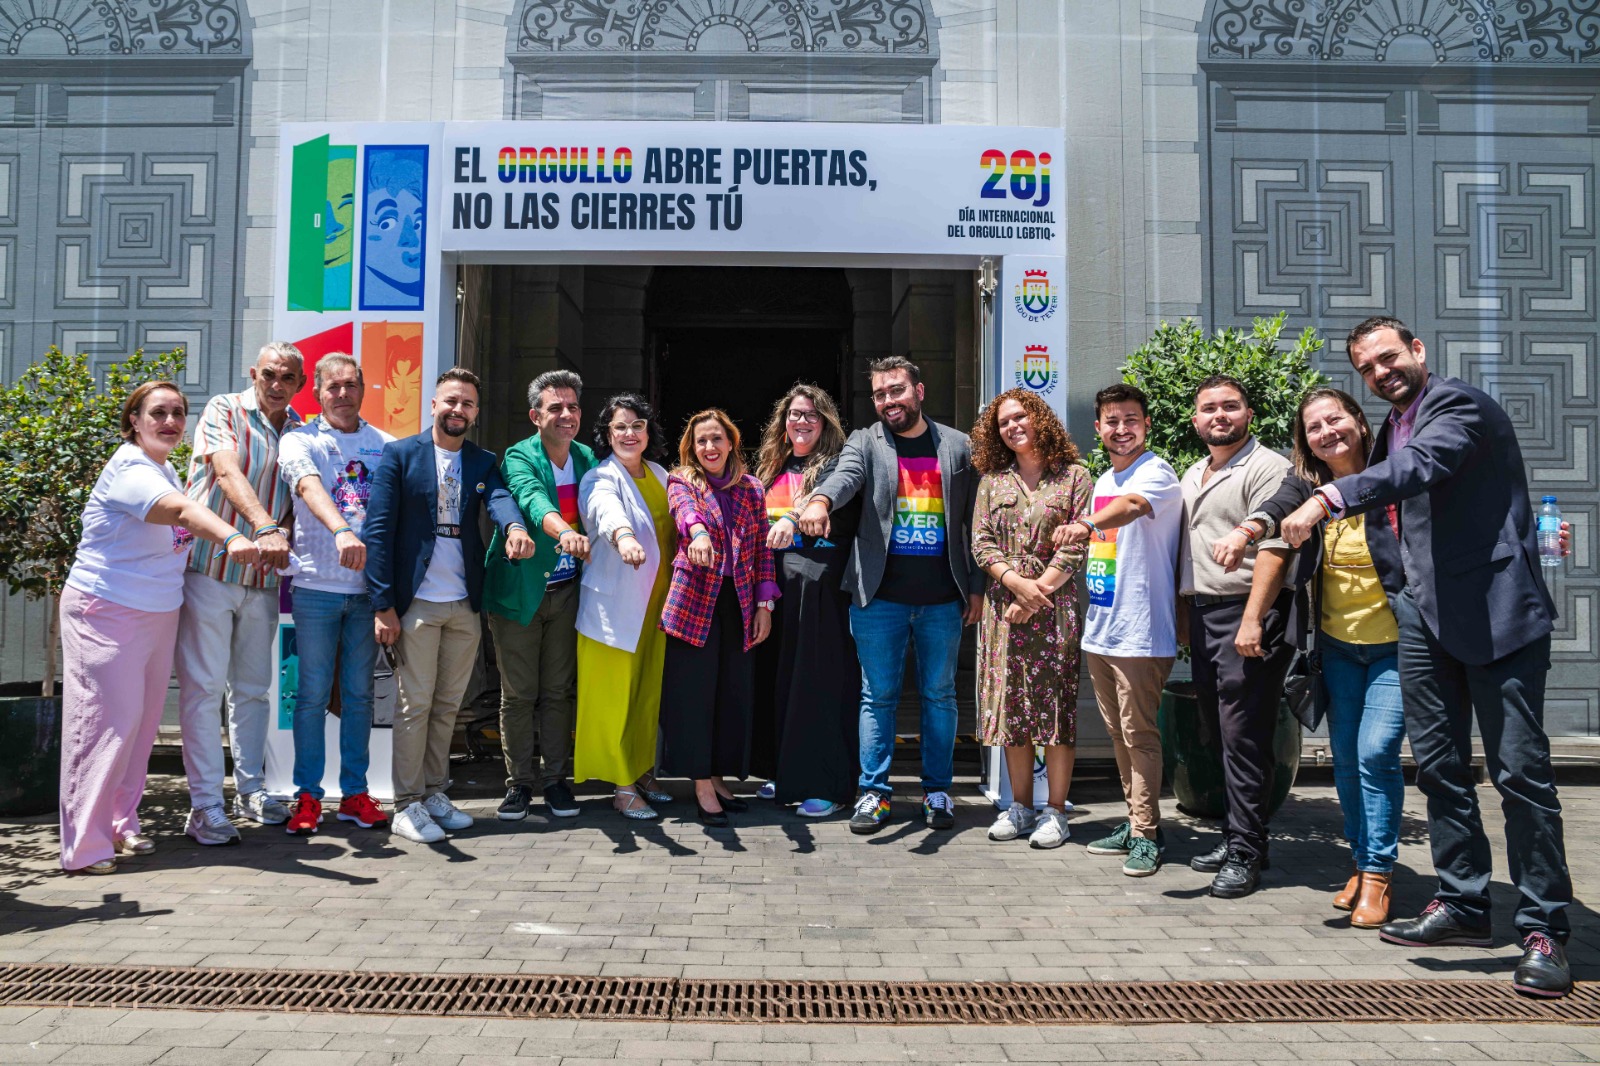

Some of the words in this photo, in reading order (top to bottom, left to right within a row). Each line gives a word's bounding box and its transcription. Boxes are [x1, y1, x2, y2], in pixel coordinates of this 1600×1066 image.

[454, 147, 486, 183] EL
[498, 147, 632, 184] ORGULLO
[643, 147, 722, 184] ABRE
[733, 148, 877, 192] PUERTAS,
[980, 149, 1052, 207] 28j
[452, 192, 493, 230] NO
[504, 192, 559, 230] LAS
[570, 192, 696, 231] CIERRES
[706, 185, 743, 231] TÚ
[958, 206, 975, 222] DÍA
[978, 209, 1056, 224] INTERNACIONAL
[947, 225, 966, 238] DEL
[968, 225, 1013, 239] ORGULLO
[1016, 226, 1056, 241] LGBTIQ+
[897, 514, 938, 529] VER
[896, 530, 937, 544] SAS
[1086, 577, 1105, 595] AS
